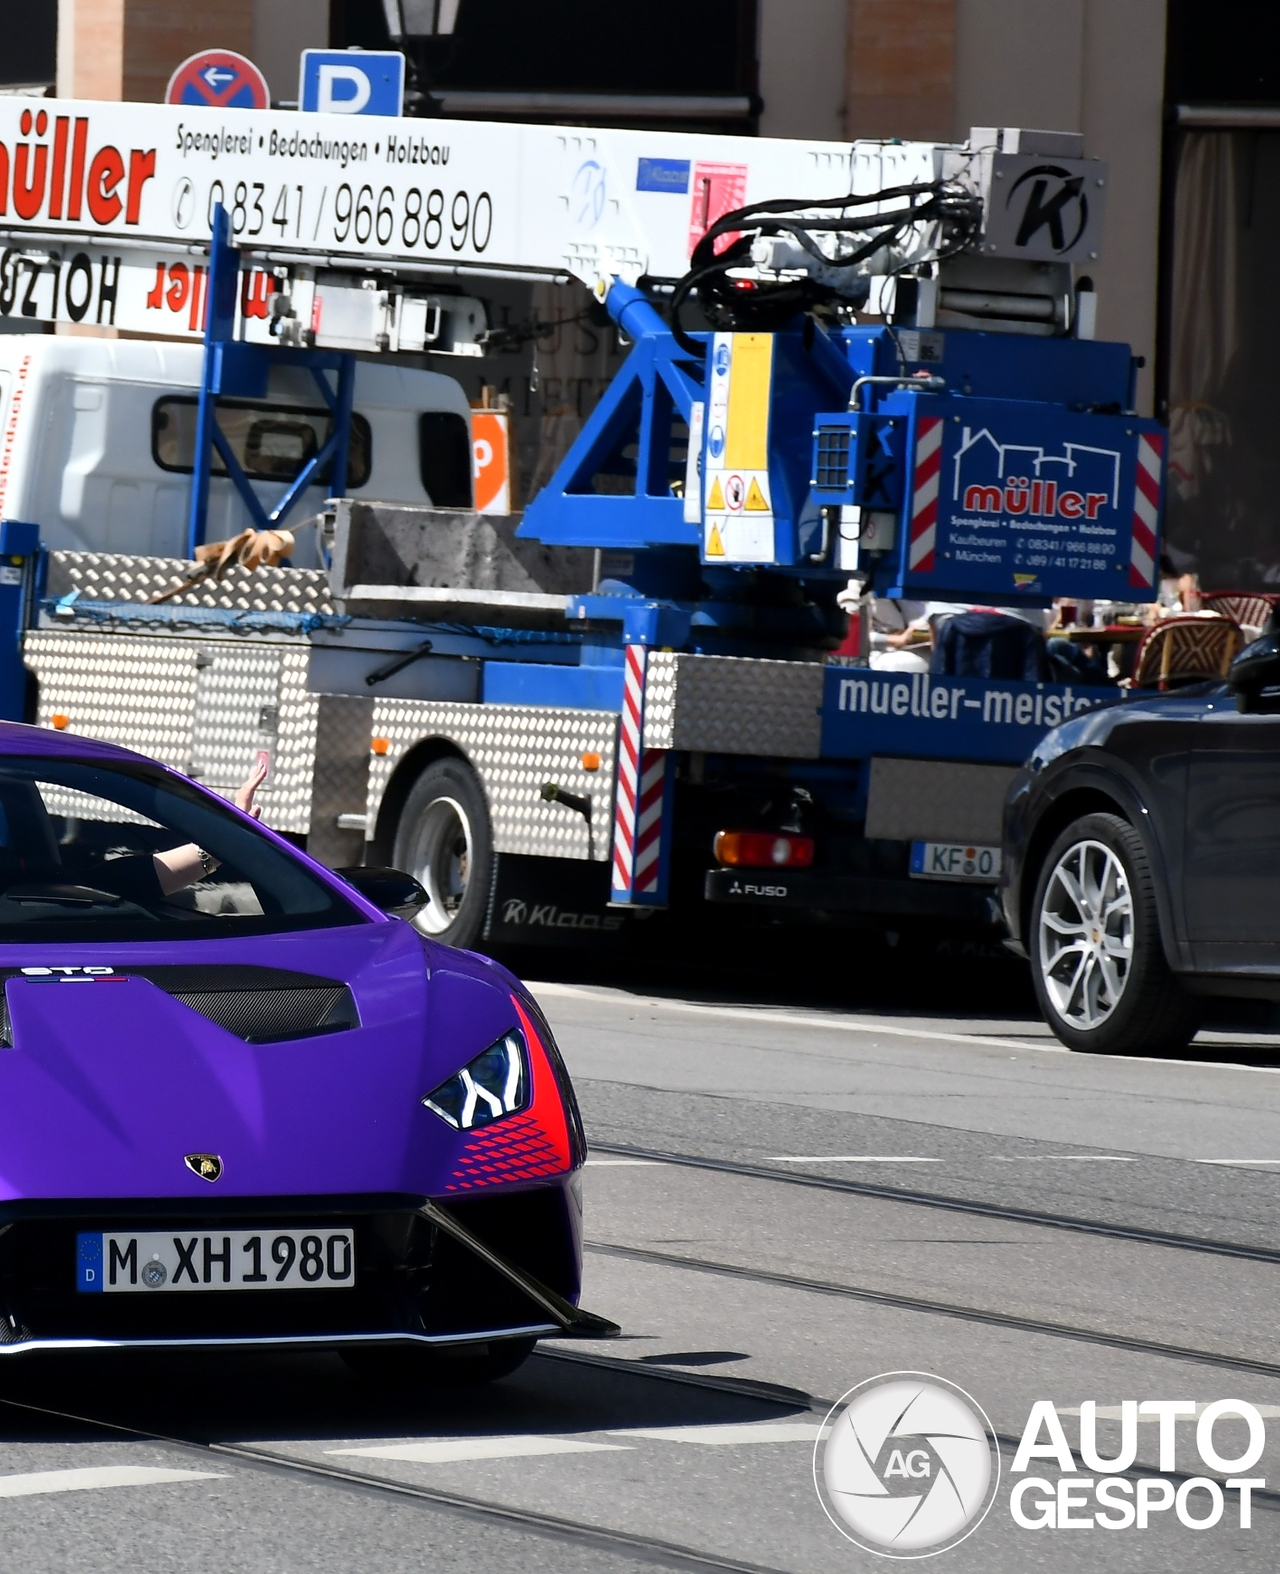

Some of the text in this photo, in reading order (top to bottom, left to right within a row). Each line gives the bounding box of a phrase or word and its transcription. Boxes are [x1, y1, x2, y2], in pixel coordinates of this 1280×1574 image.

[317, 64, 372, 114] P
[176, 122, 451, 168] Spenglerei Bedachungen Holzbau
[963, 476, 1108, 520] müller
[949, 533, 1007, 548] Kaufbeuren
[955, 550, 1002, 563] München
[839, 673, 1128, 728] mueller-meiste
[932, 847, 961, 871] KF
[745, 884, 788, 897] FUSO
[528, 904, 625, 930] Klaas
[21, 966, 114, 975] STO
[109, 1235, 352, 1285] M XH 1980
[85, 1268, 95, 1282] D
